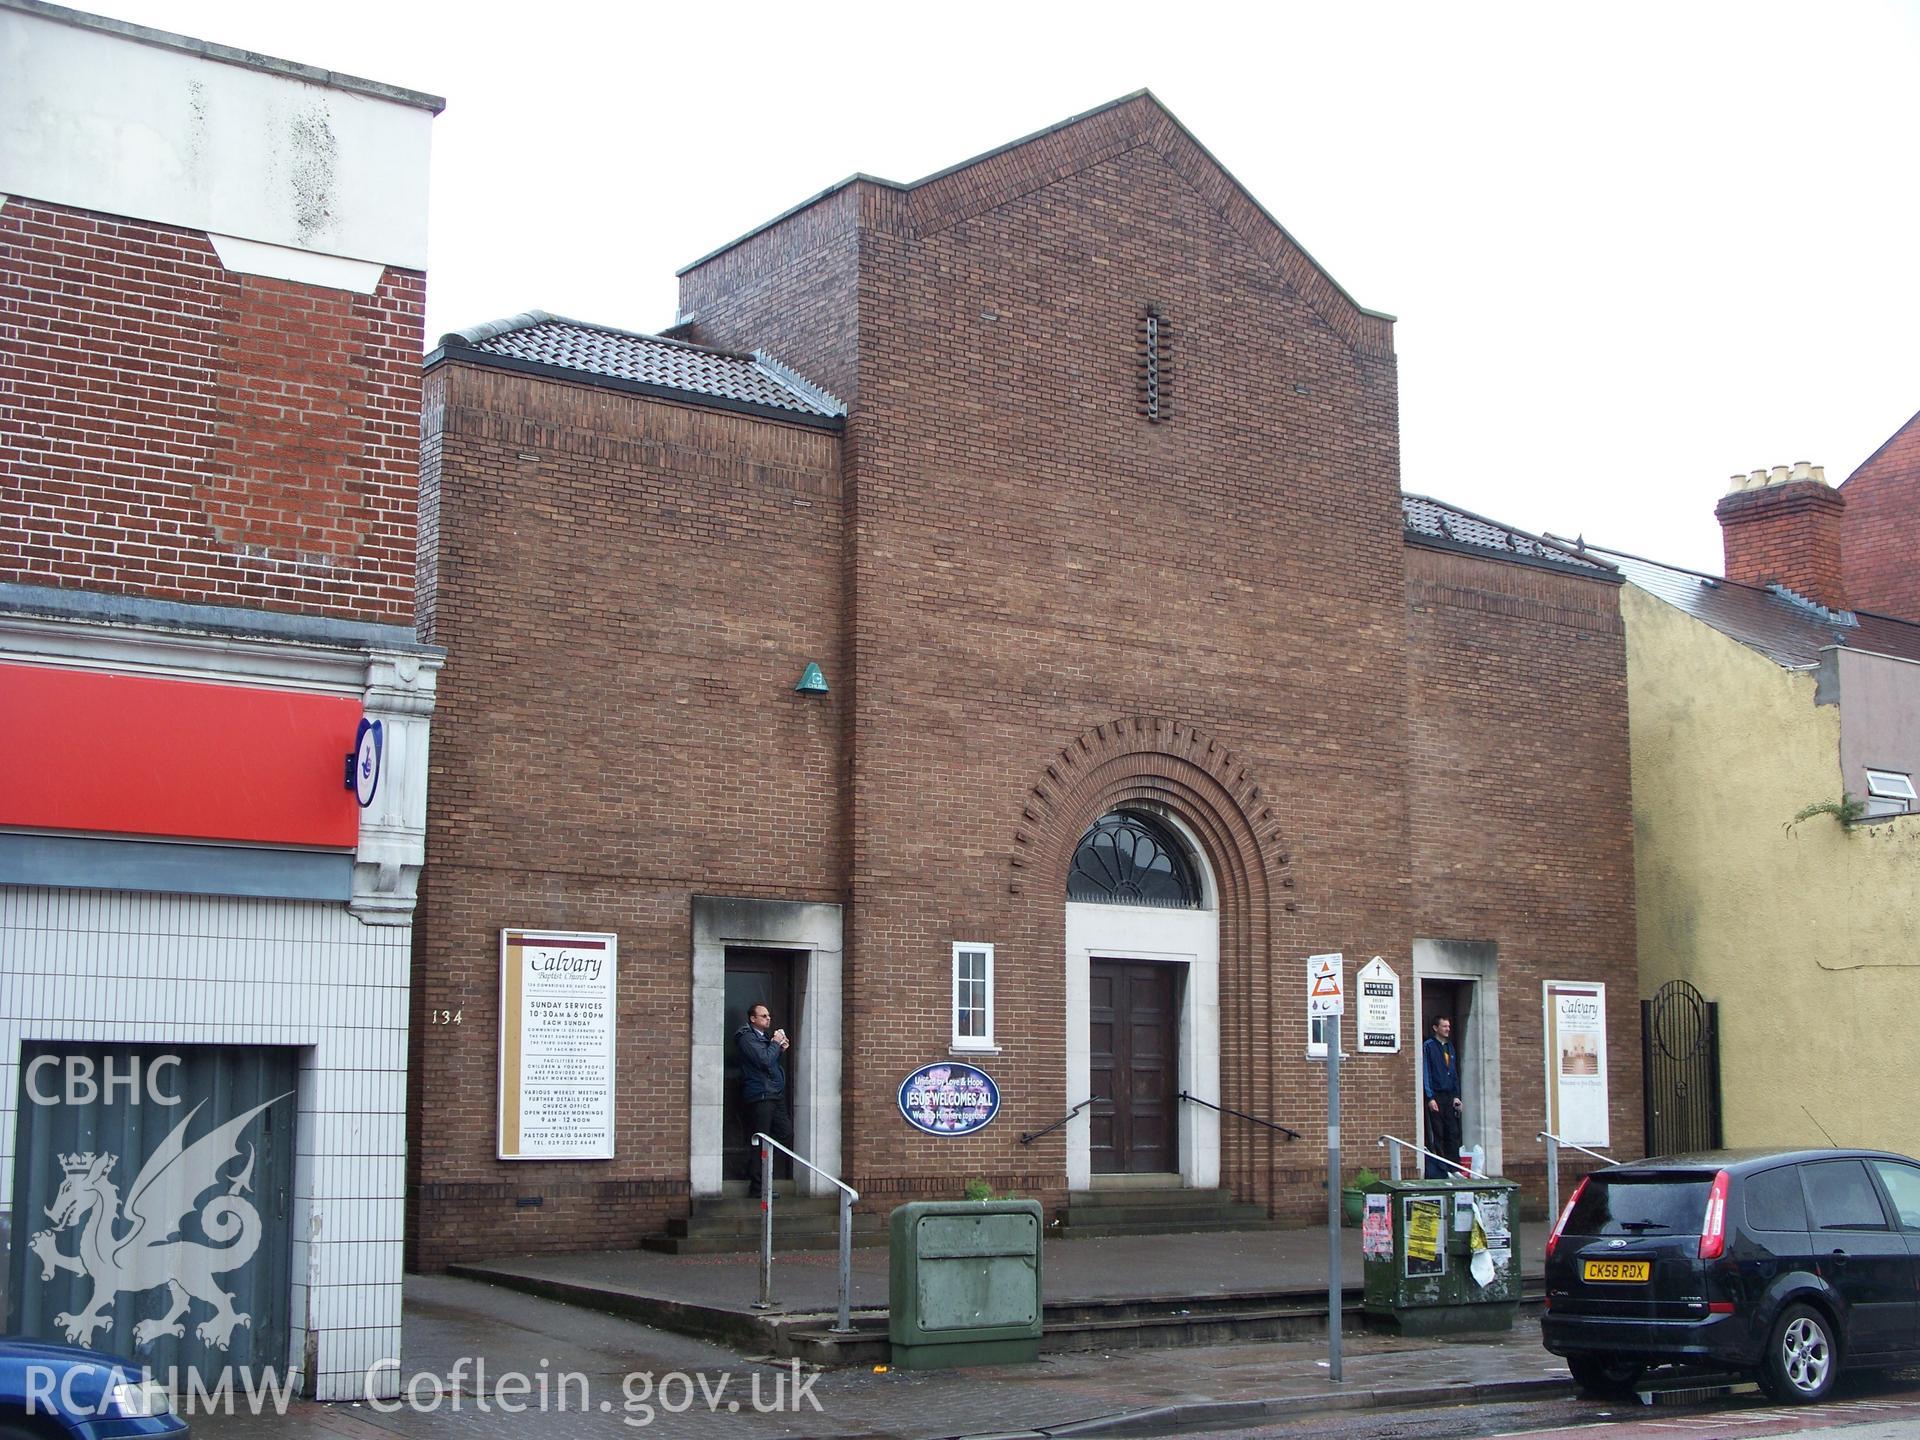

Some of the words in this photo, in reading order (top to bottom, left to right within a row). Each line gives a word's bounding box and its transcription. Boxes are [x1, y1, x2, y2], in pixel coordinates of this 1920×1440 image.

[532, 951, 602, 980] Calvary
[538, 972, 562, 981] Baptist
[564, 972, 587, 980] Church
[531, 1001, 562, 1009] SUNDAY
[564, 1002, 602, 1010] SERVICES
[1561, 998, 1598, 1020] Calvary
[432, 1010, 462, 1025] 134
[914, 1076, 936, 1085] Unified
[937, 1078, 944, 1087] by
[946, 1078, 959, 1086] Love
[961, 1078, 967, 1086] &
[967, 1077, 984, 1087] Hope
[906, 1092, 931, 1109] JESUS
[931, 1092, 976, 1106] WELCOMES
[978, 1092, 993, 1106] ALL
[947, 1111, 962, 1119] here
[963, 1111, 987, 1121] together
[1589, 1264, 1619, 1278] CK58
[1621, 1264, 1645, 1278] RDX
